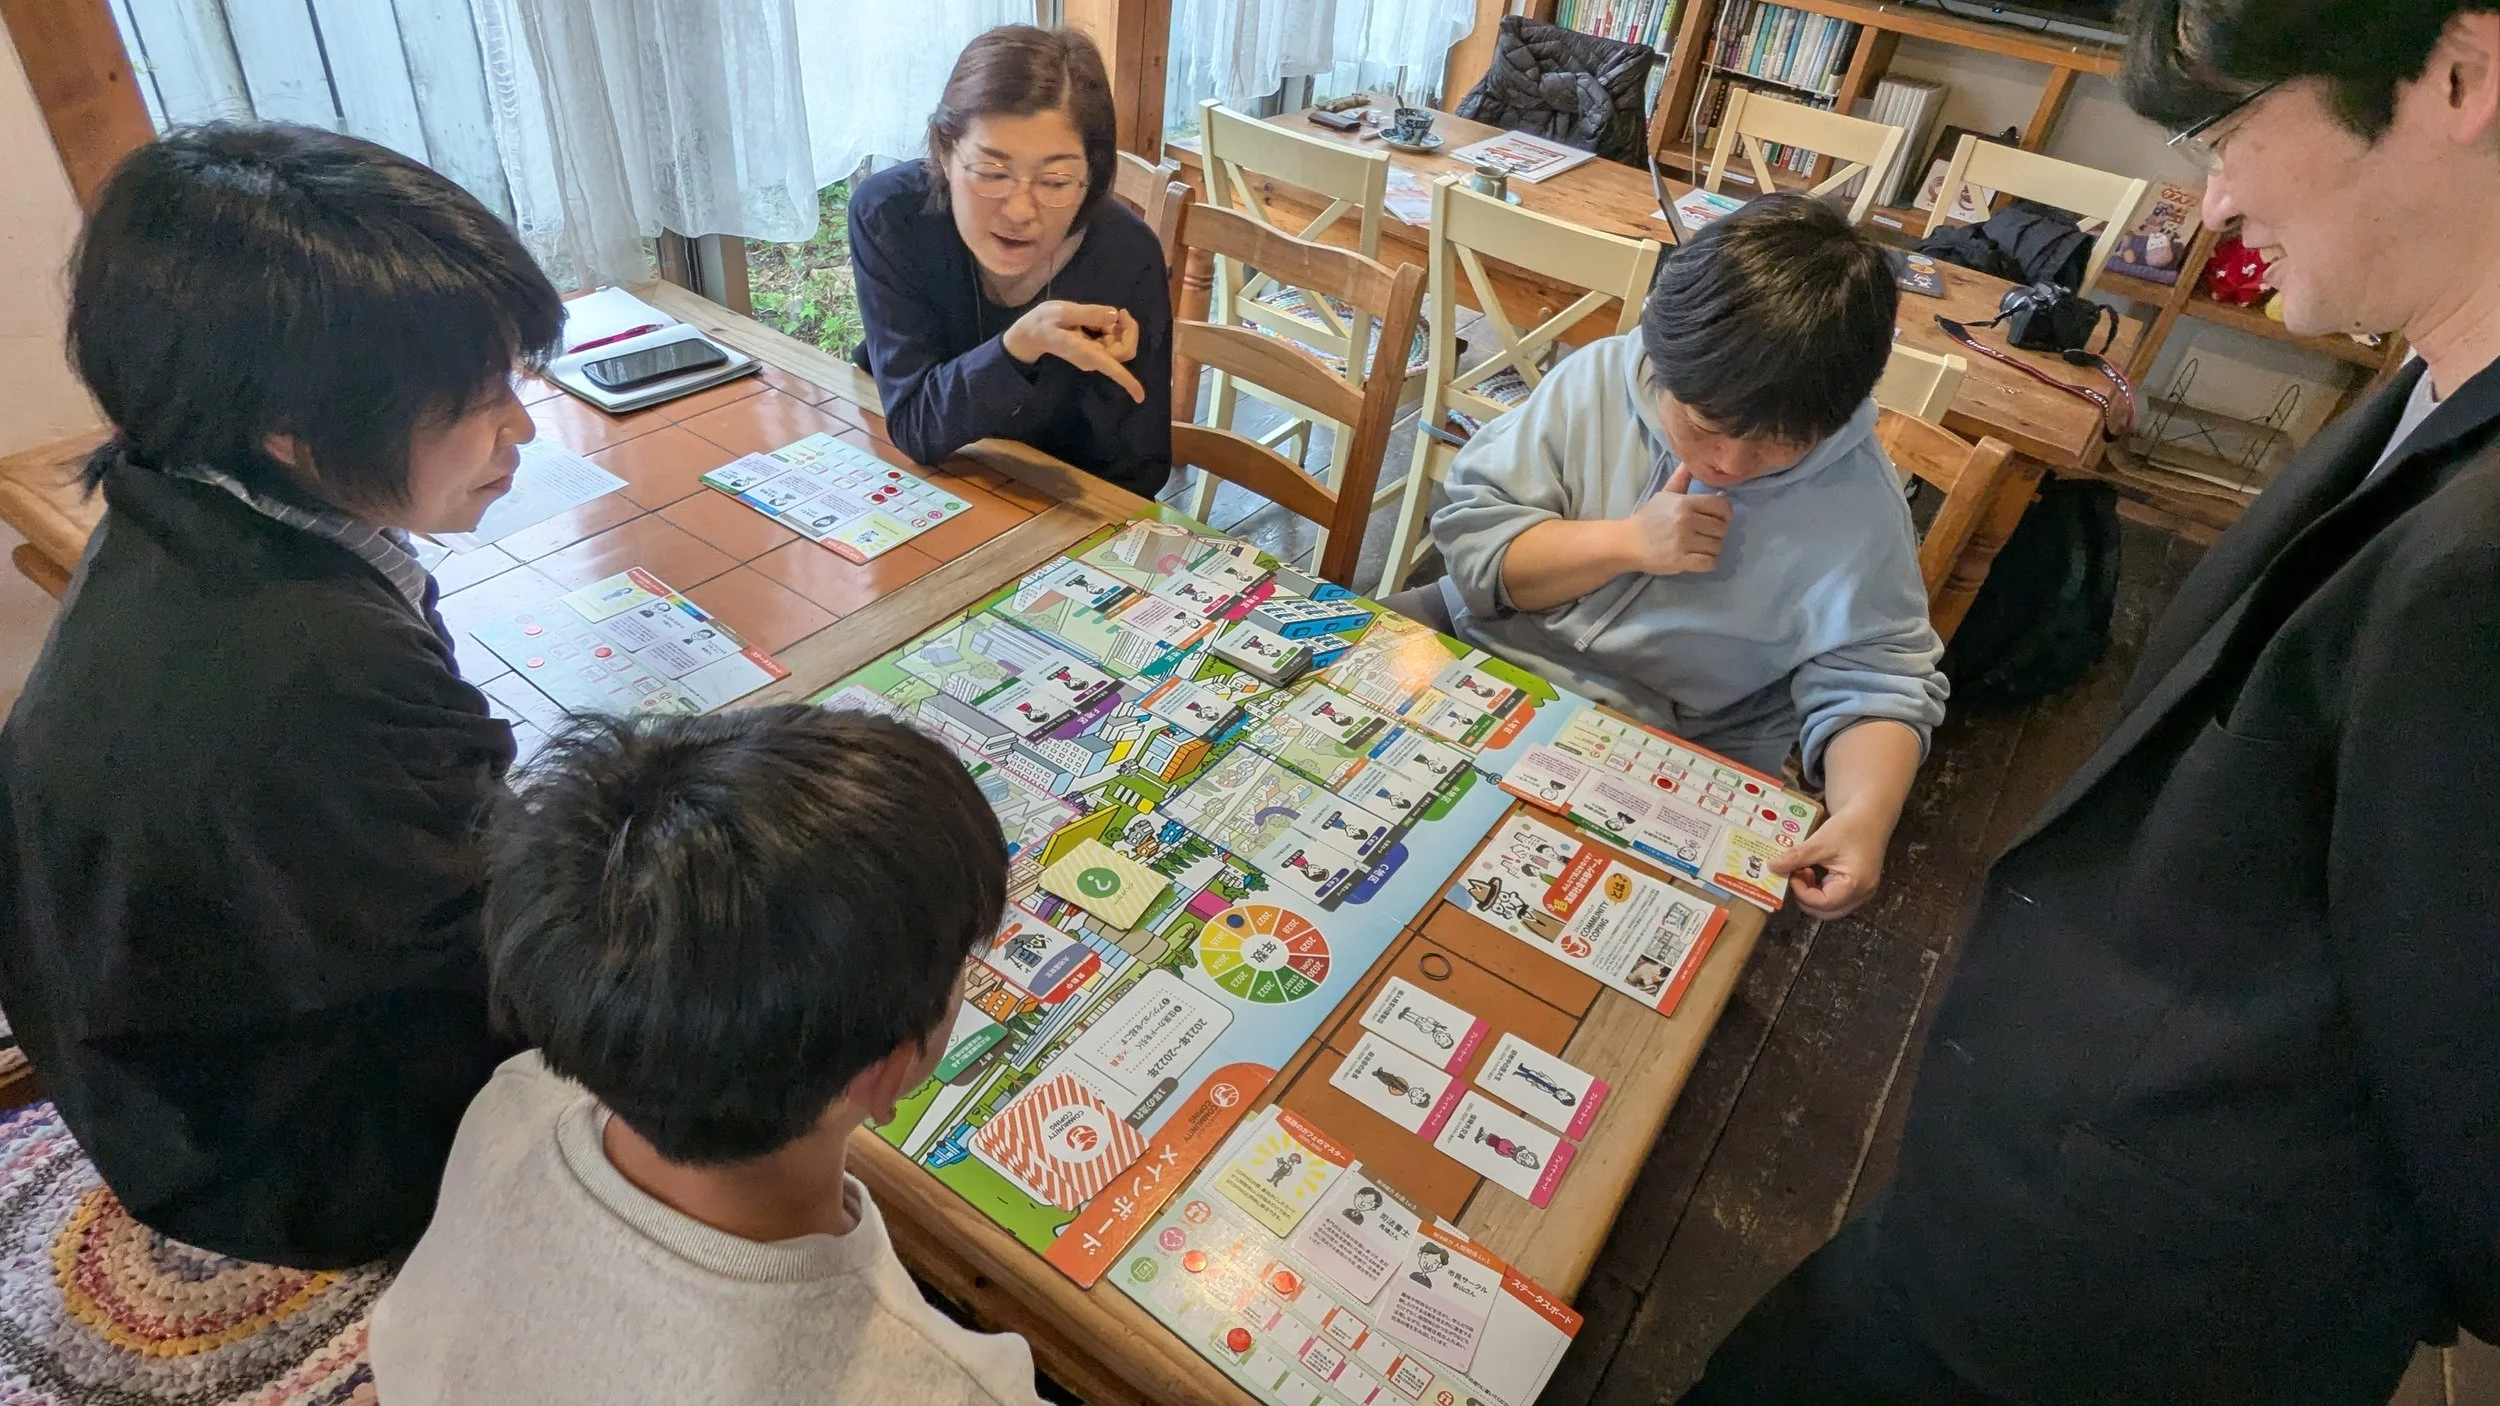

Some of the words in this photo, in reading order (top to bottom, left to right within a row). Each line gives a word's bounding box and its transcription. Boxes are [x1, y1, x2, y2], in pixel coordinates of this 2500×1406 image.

[1366, 862, 1389, 885] C地区
[1255, 910, 1271, 926] 2027
[1579, 900, 1609, 938] COMMUNITY
[1588, 917, 1609, 942] COPING
[1249, 938, 1278, 965] 年数
[1229, 970, 1248, 988] 2023
[1306, 960, 1323, 978] 2030
[1255, 979, 1274, 997] 2022
[1289, 977, 1307, 996] 2021
[1131, 1086, 1167, 1122] 1年の流れ
[1187, 1097, 1212, 1125] COPING
[1047, 1109, 1084, 1140] COMMUNITY
[1048, 1109, 1073, 1131] COPING
[1180, 1102, 1218, 1142] COMMUNITY
[1075, 1142, 1181, 1256] メインボード
[1378, 1211, 1411, 1239] 司法書士
[1446, 1268, 1489, 1295] 市民サークル
[1510, 1277, 1574, 1326] ステータスボード
